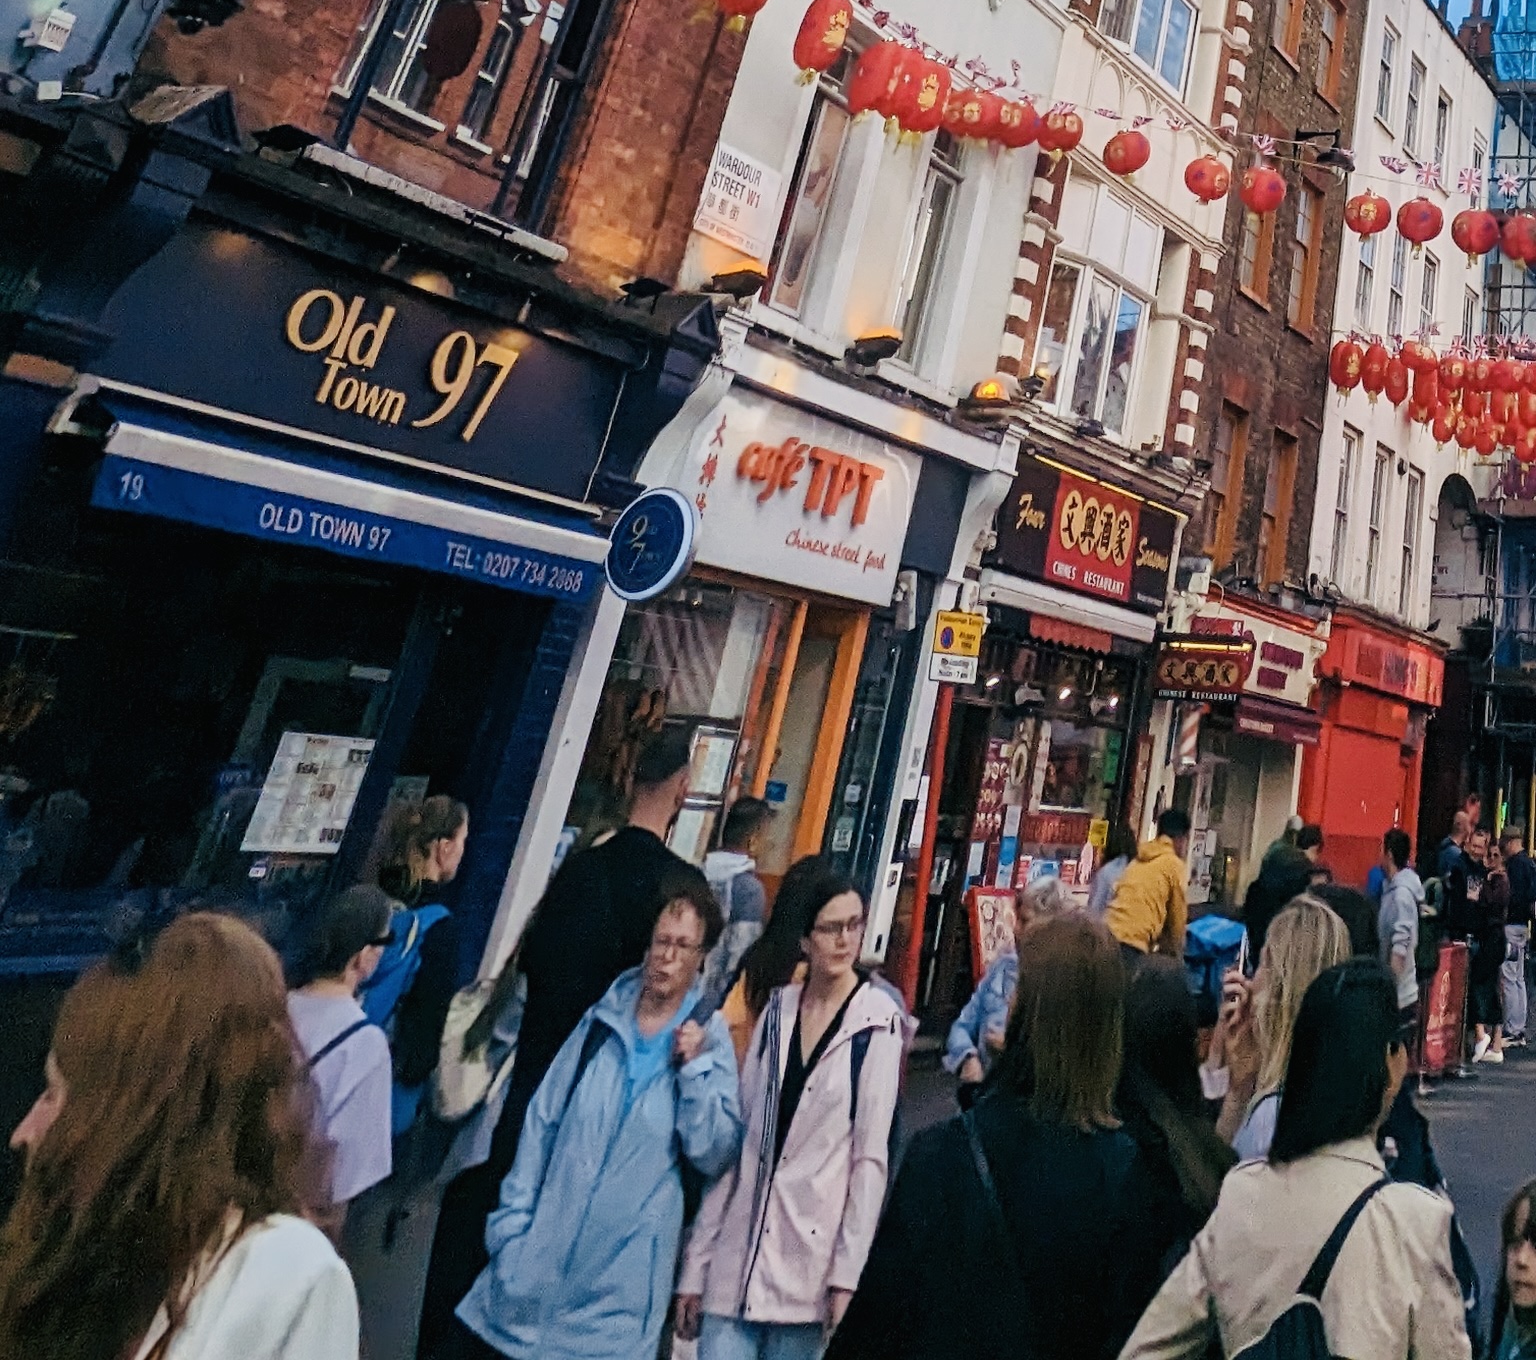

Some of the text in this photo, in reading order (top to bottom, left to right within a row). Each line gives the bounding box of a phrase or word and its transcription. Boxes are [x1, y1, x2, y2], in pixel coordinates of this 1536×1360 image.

[711, 171, 762, 209] STREET W1
[717, 149, 763, 187] WARDOUR
[286, 288, 520, 443] Old 97
[315, 356, 408, 426] Town
[803, 446, 885, 528] TPT
[119, 471, 145, 501] 19
[259, 502, 303, 534] OLD
[308, 511, 366, 549] TOWN
[366, 527, 392, 553] 97
[482, 551, 521, 579] 0207
[520, 560, 548, 586] 734
[785, 528, 886, 573] Chinese street food
[1062, 496, 1130, 561] 文興酒家
[1083, 570, 1125, 596] RESTAURANT
